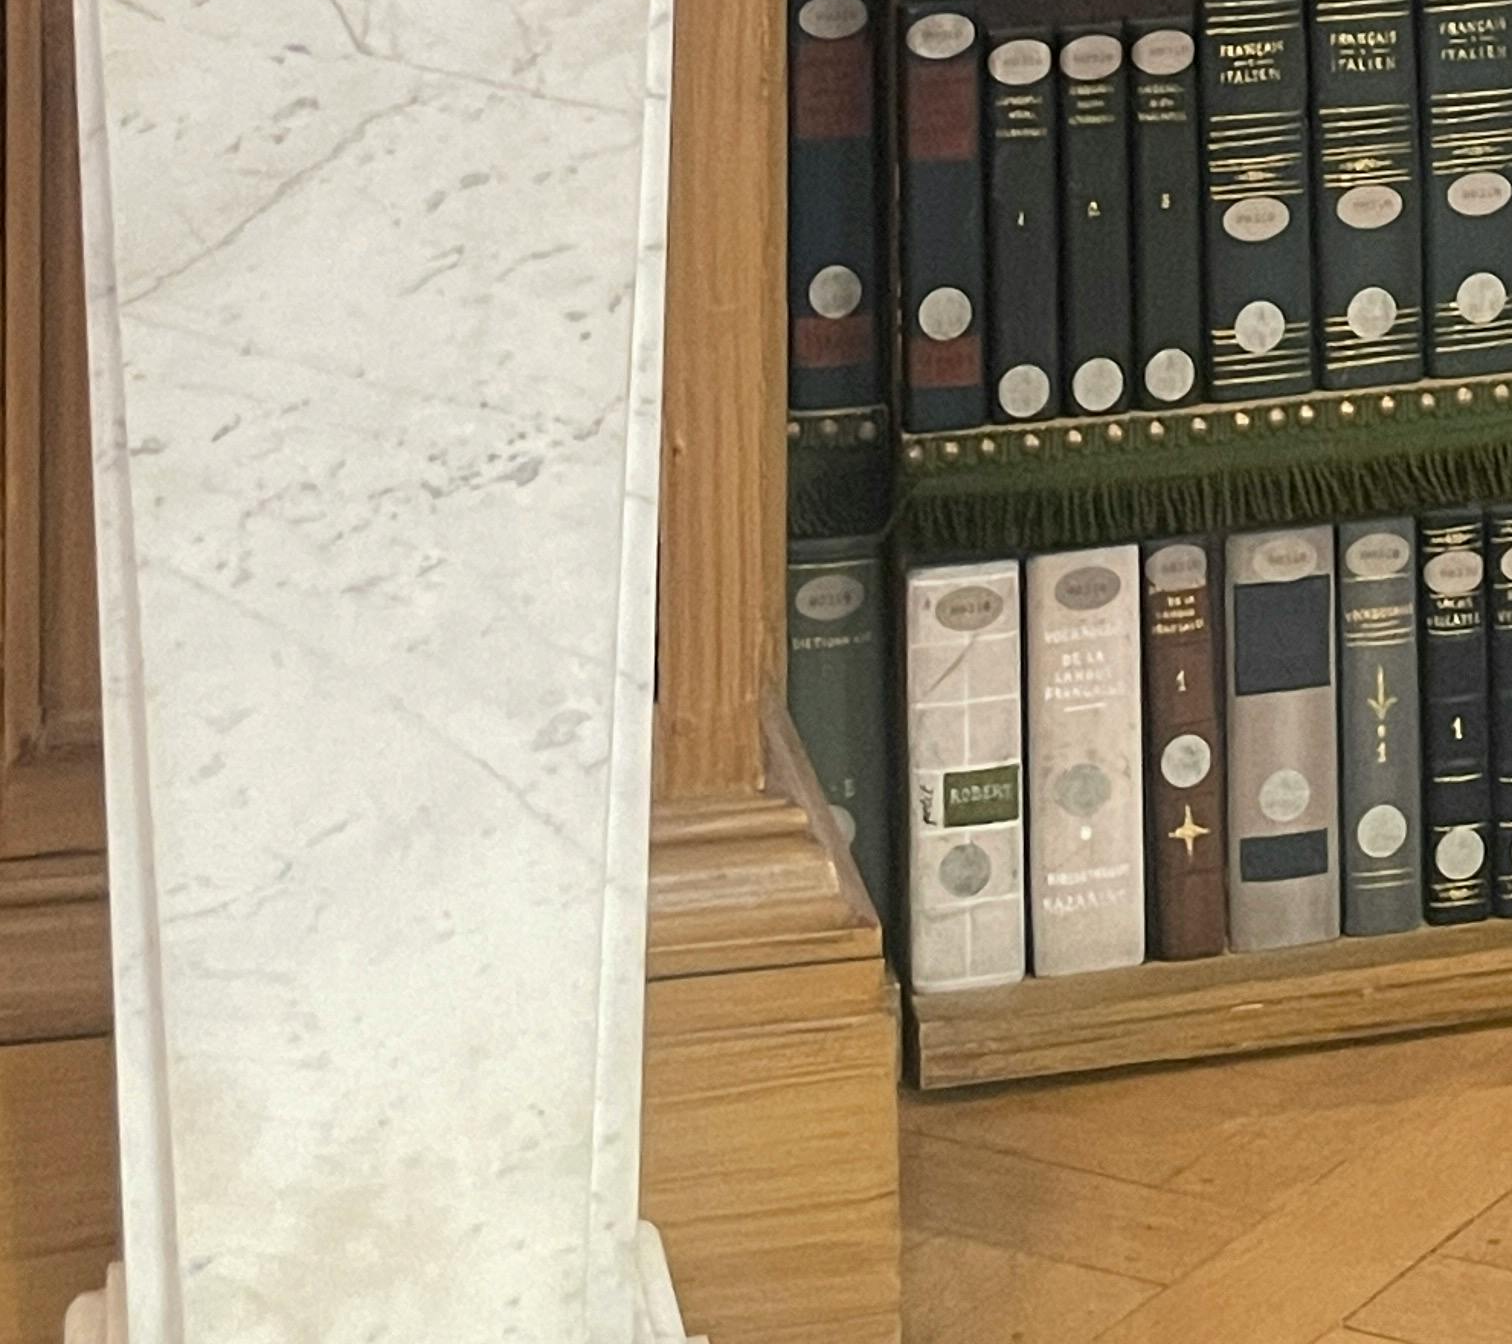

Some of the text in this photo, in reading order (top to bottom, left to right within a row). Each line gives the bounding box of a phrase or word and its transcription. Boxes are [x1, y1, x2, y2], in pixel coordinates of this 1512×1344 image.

[1176, 669, 1187, 692] 1
[1452, 716, 1464, 740] 1
[949, 783, 1013, 805] ROBERT
